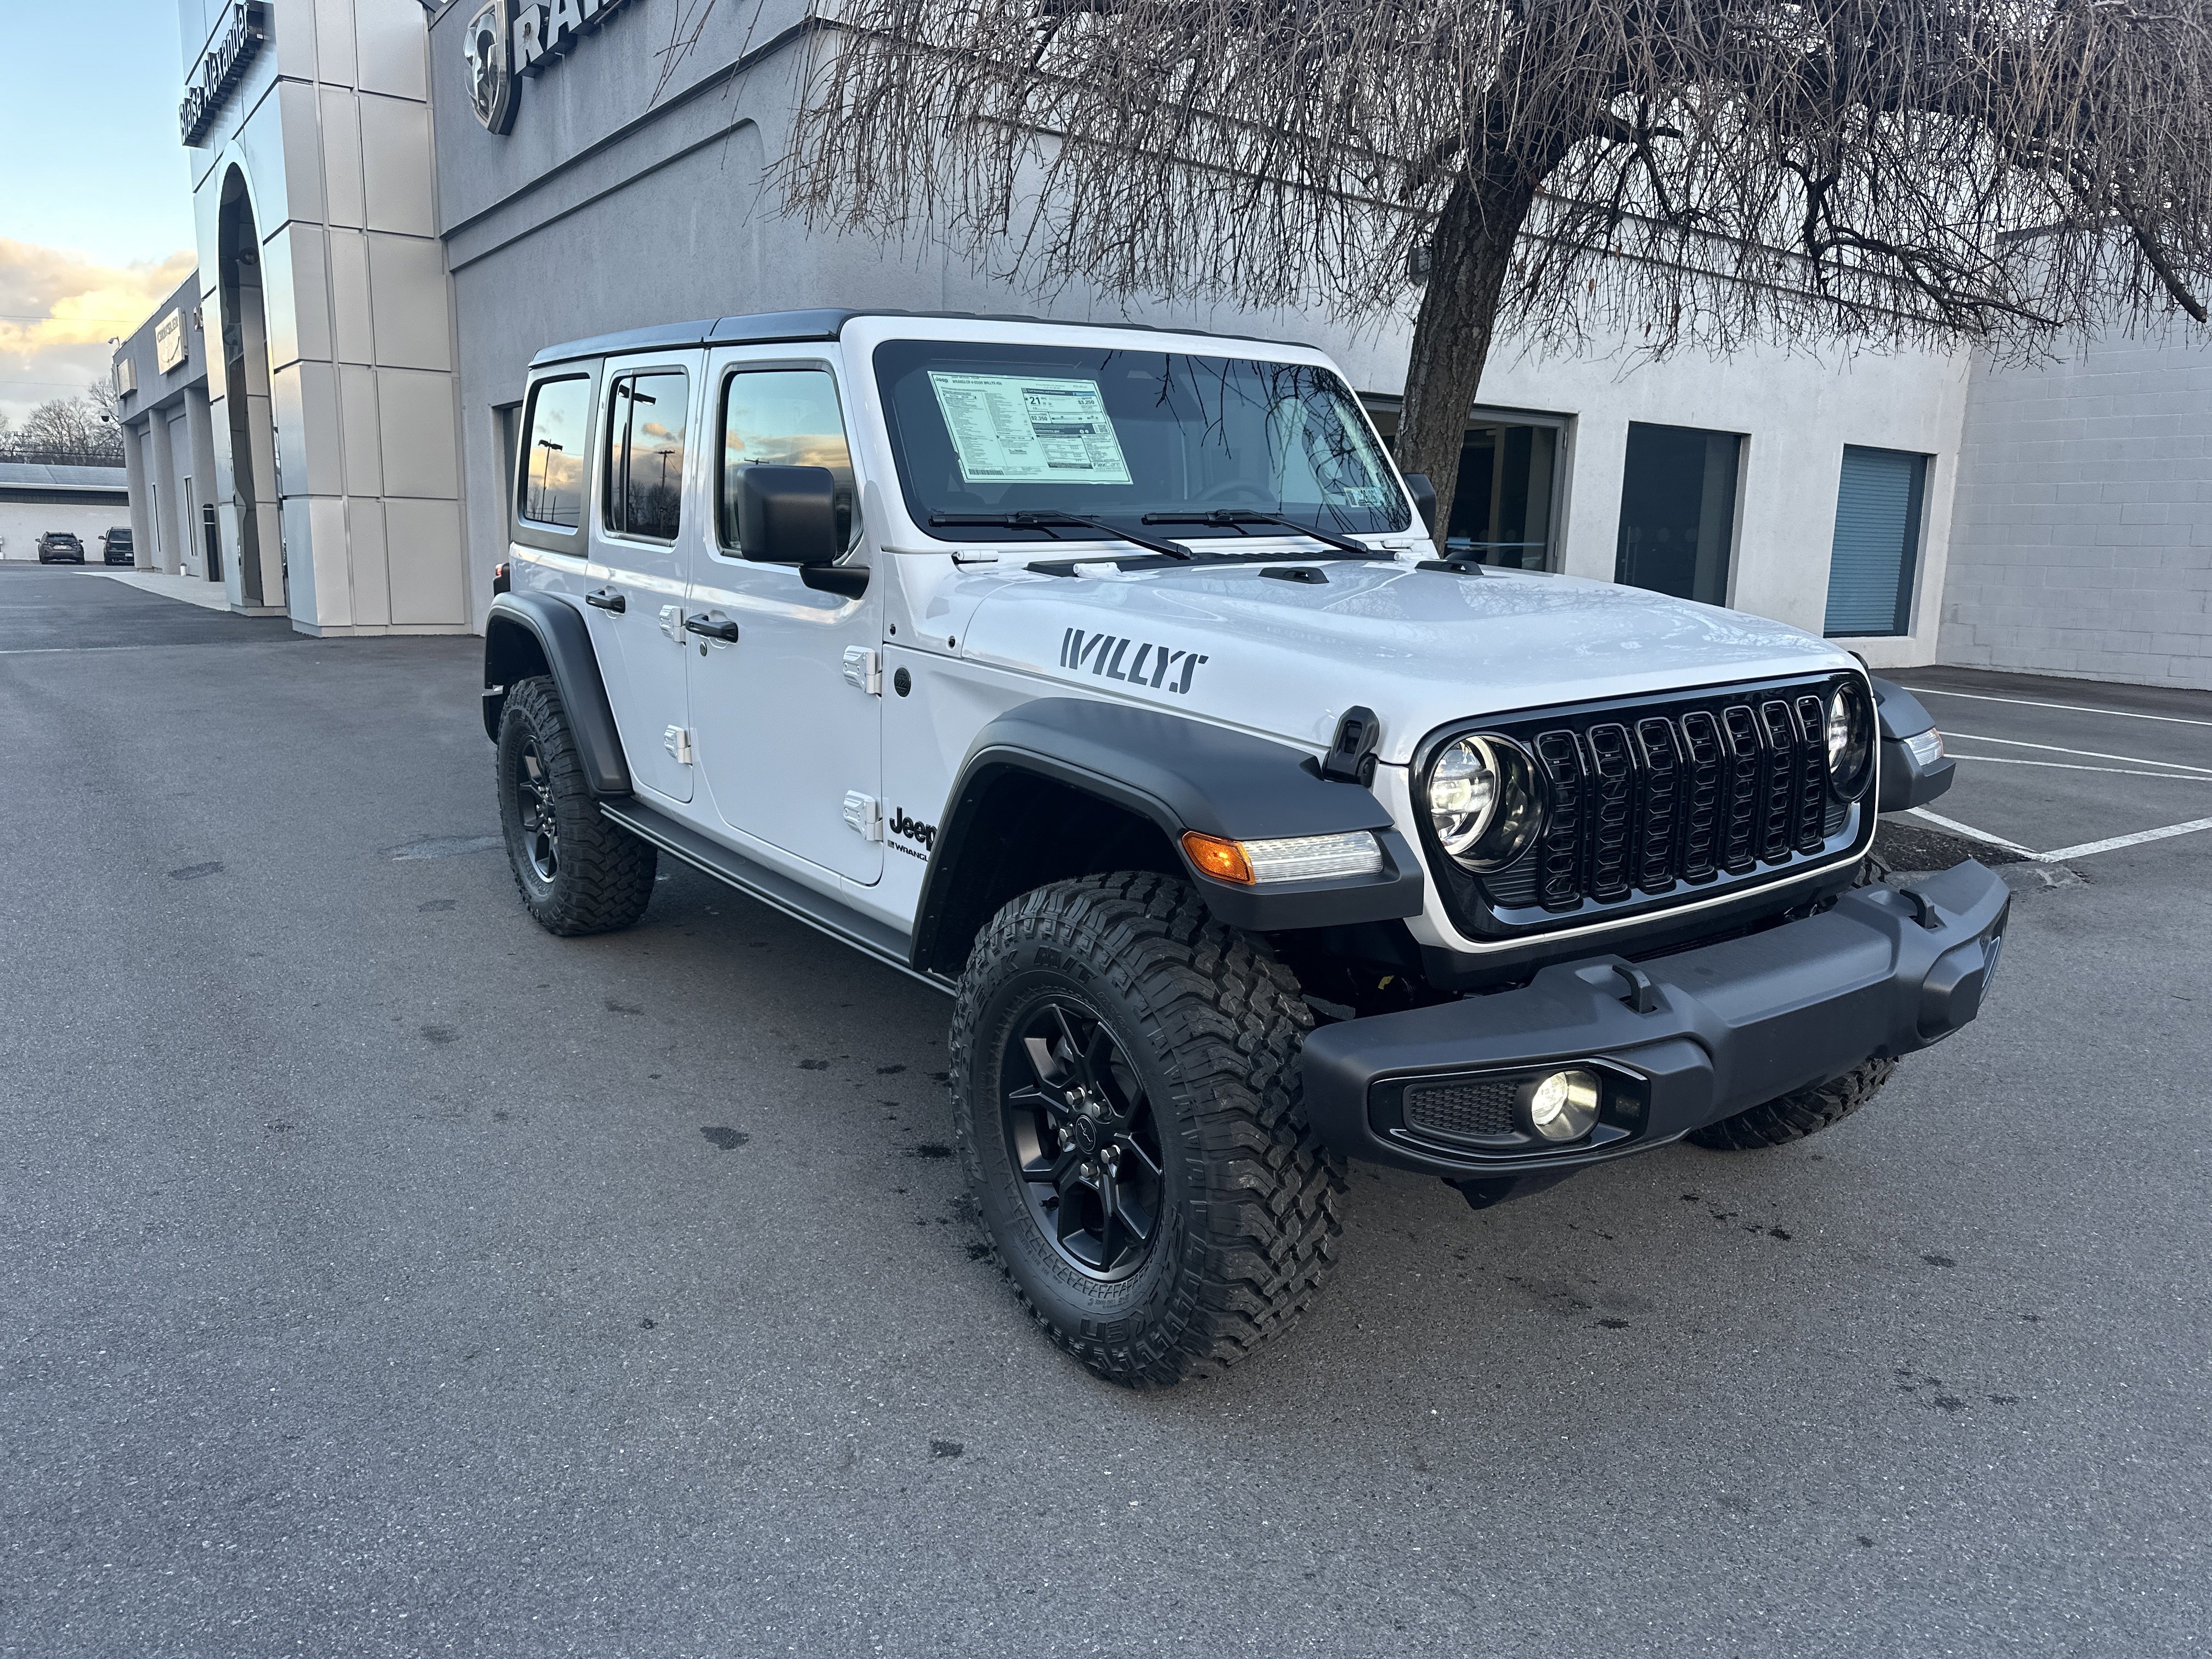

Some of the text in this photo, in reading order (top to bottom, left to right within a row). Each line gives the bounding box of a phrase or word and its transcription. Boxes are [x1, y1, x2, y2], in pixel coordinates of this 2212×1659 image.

[513, 0, 610, 75] RA
[179, 2, 249, 146] Blaise Alexander
[1029, 397, 1041, 405] 21
[1060, 627, 1209, 695] WILLYS
[889, 806, 938, 852] Jeep
[895, 842, 929, 862] WRANGL
